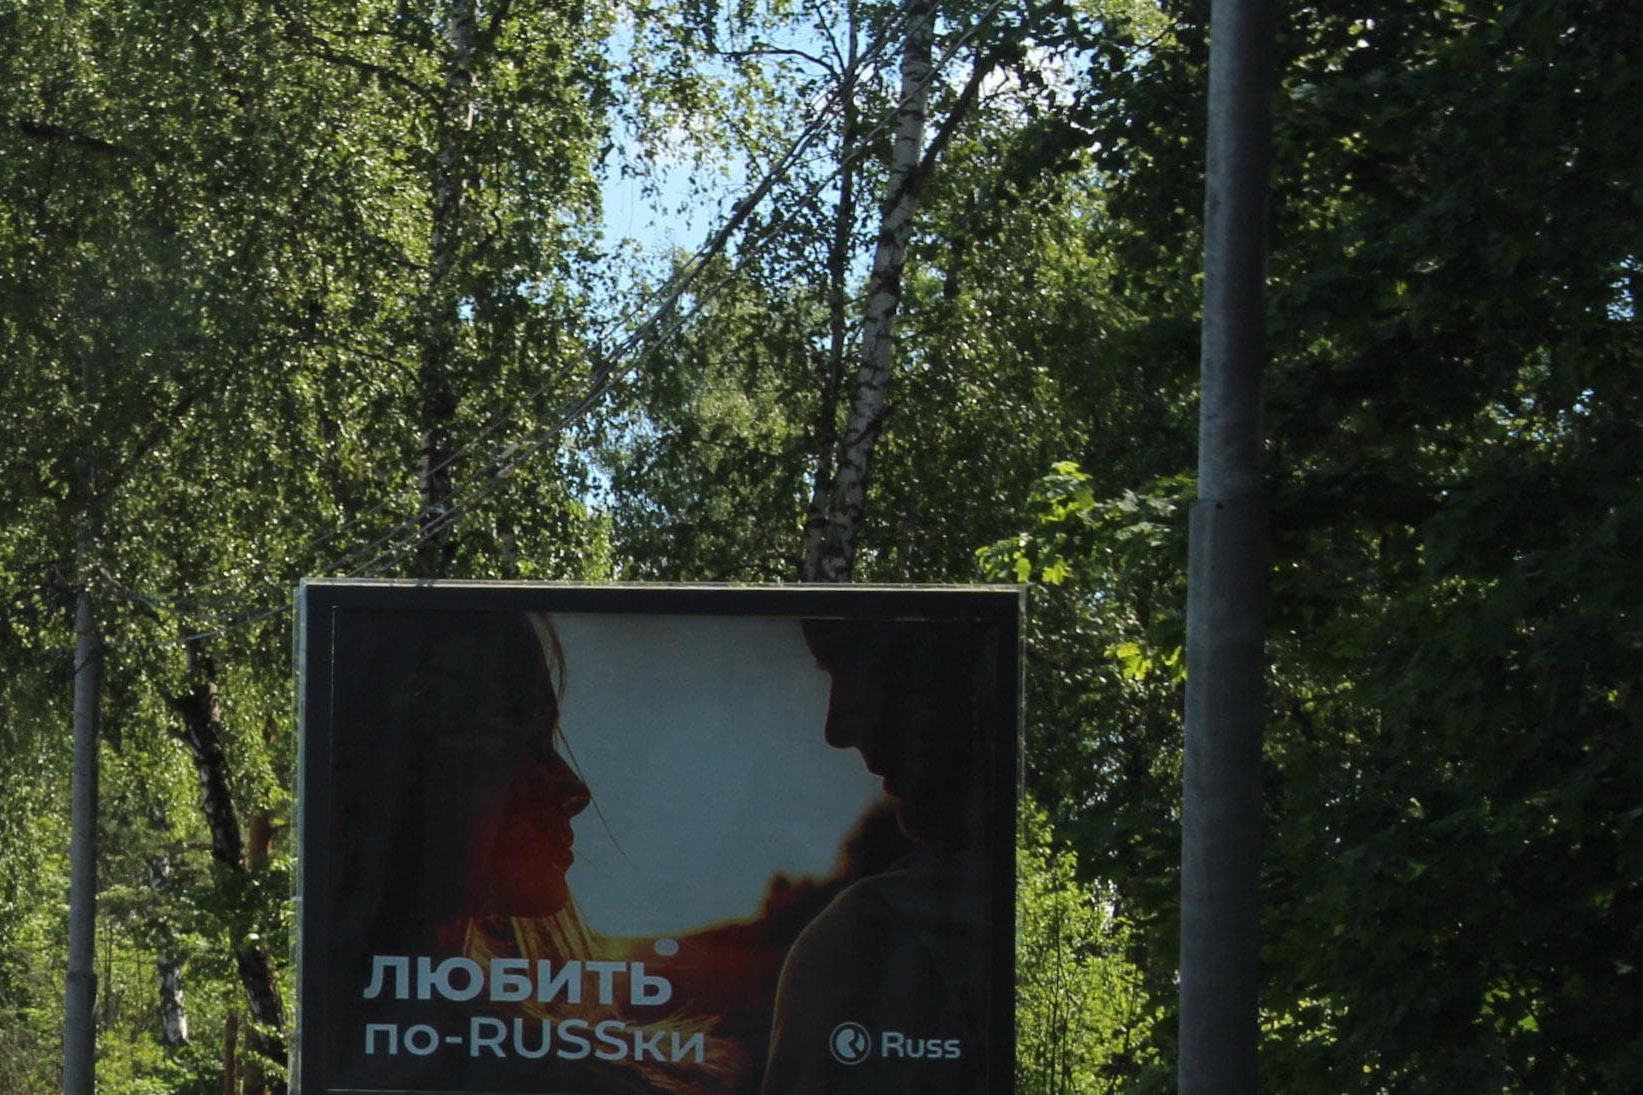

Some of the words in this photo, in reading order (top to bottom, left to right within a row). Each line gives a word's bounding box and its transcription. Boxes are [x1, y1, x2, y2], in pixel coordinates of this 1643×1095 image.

[363, 954, 673, 1006] ЛЮБИТЬ
[364, 1017, 705, 1064] по-RUSSки
[881, 1031, 962, 1059] Russ
